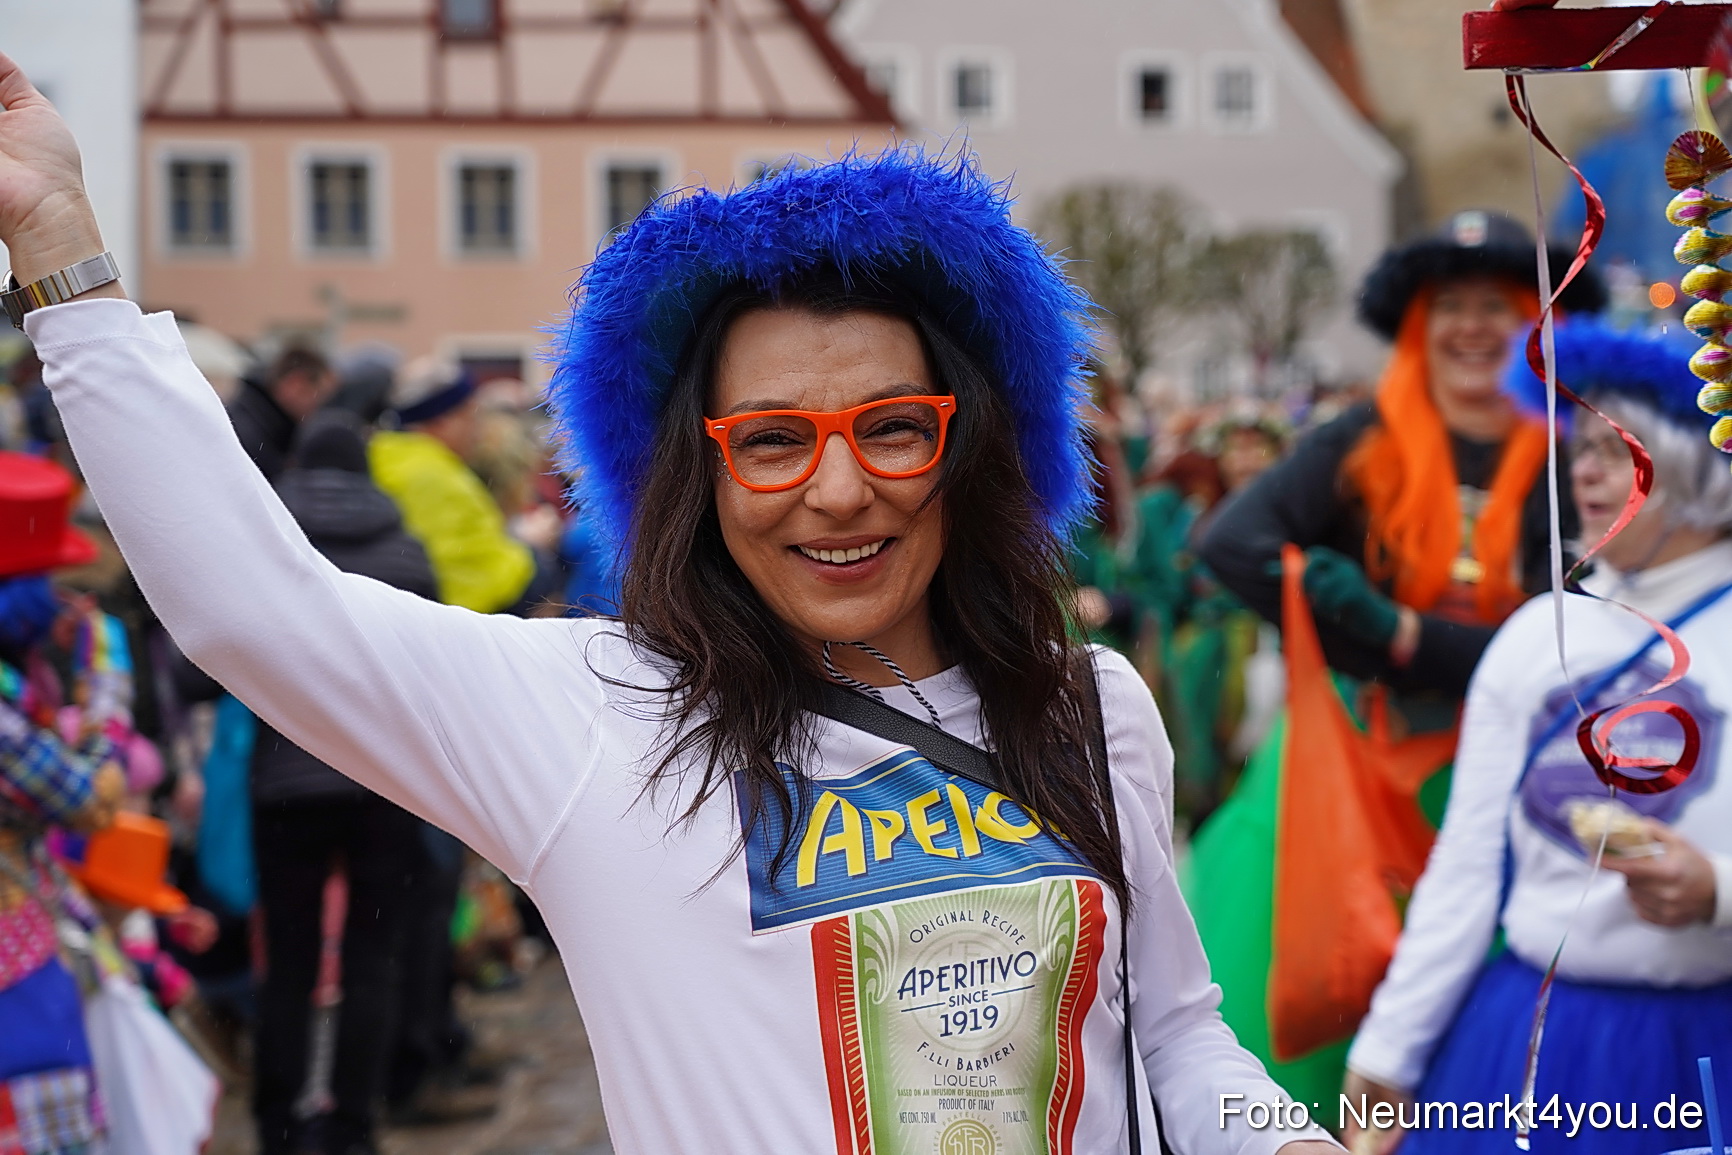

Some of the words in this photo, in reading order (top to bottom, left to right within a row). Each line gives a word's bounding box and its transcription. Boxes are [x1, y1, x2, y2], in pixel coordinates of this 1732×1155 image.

[910, 910, 974, 943] ORIGINAL
[982, 910, 1026, 945] RECIPE
[897, 951, 1037, 1000] APERITIVO
[948, 990, 989, 1007] SINCE
[939, 1005, 999, 1037] 1919
[956, 1043, 1015, 1072] BARBIERI
[934, 1074, 998, 1088] LIQUEUR
[897, 1089, 912, 1097] BASED
[965, 1089, 989, 1098] SELECTED
[938, 1098, 966, 1110] PRODUCT
[967, 1098, 977, 1110] OF
[978, 1099, 995, 1111] ITALY
